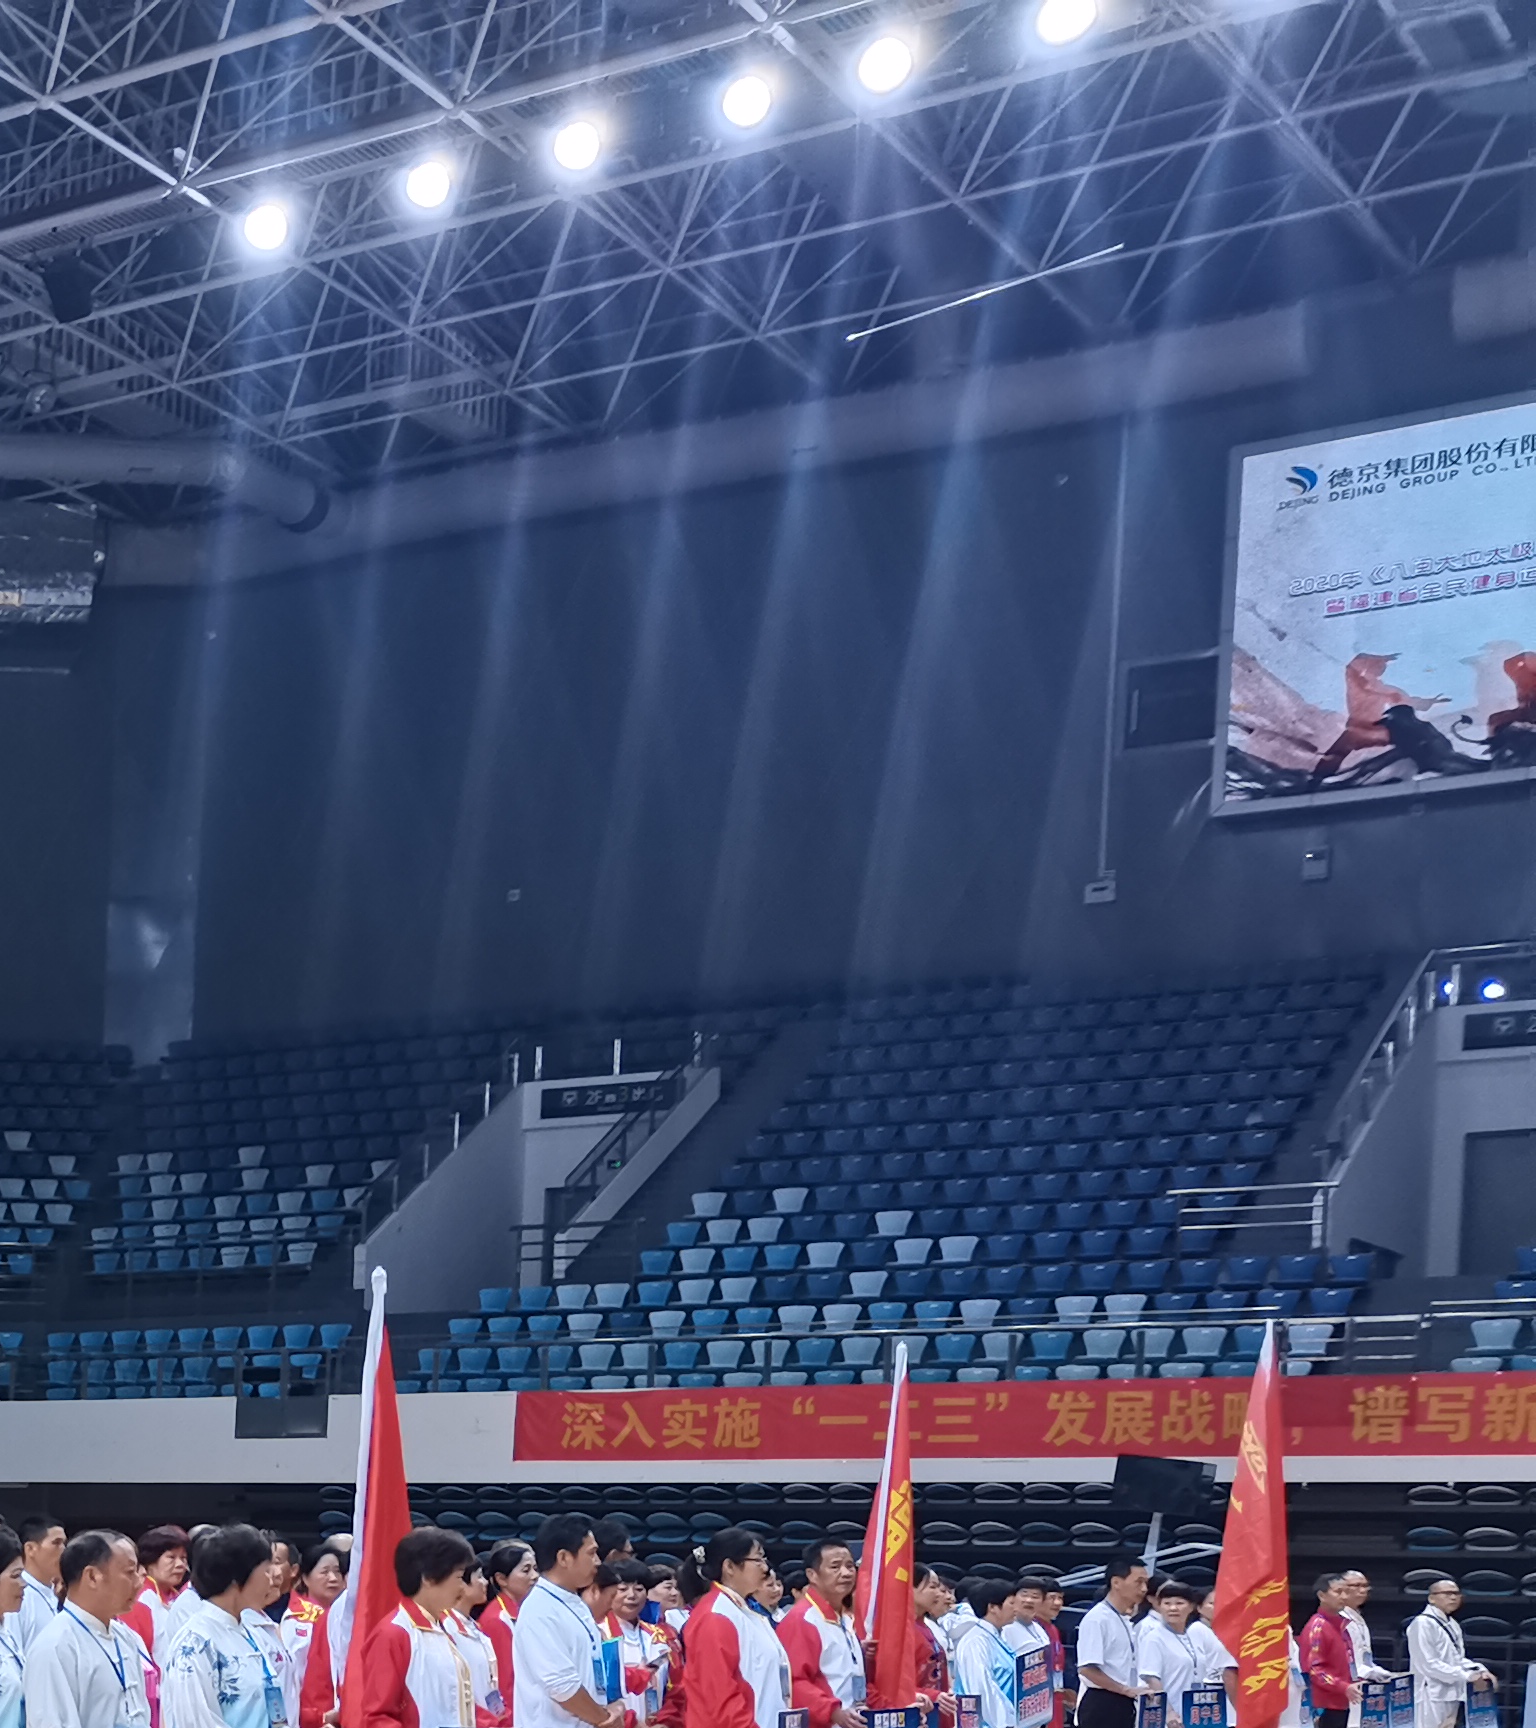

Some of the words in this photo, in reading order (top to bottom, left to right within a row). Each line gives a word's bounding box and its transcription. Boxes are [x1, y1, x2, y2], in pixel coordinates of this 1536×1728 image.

[1328, 483, 1386, 502] DEJING
[1399, 469, 1459, 490] GROUP
[1514, 455, 1536, 469] LT
